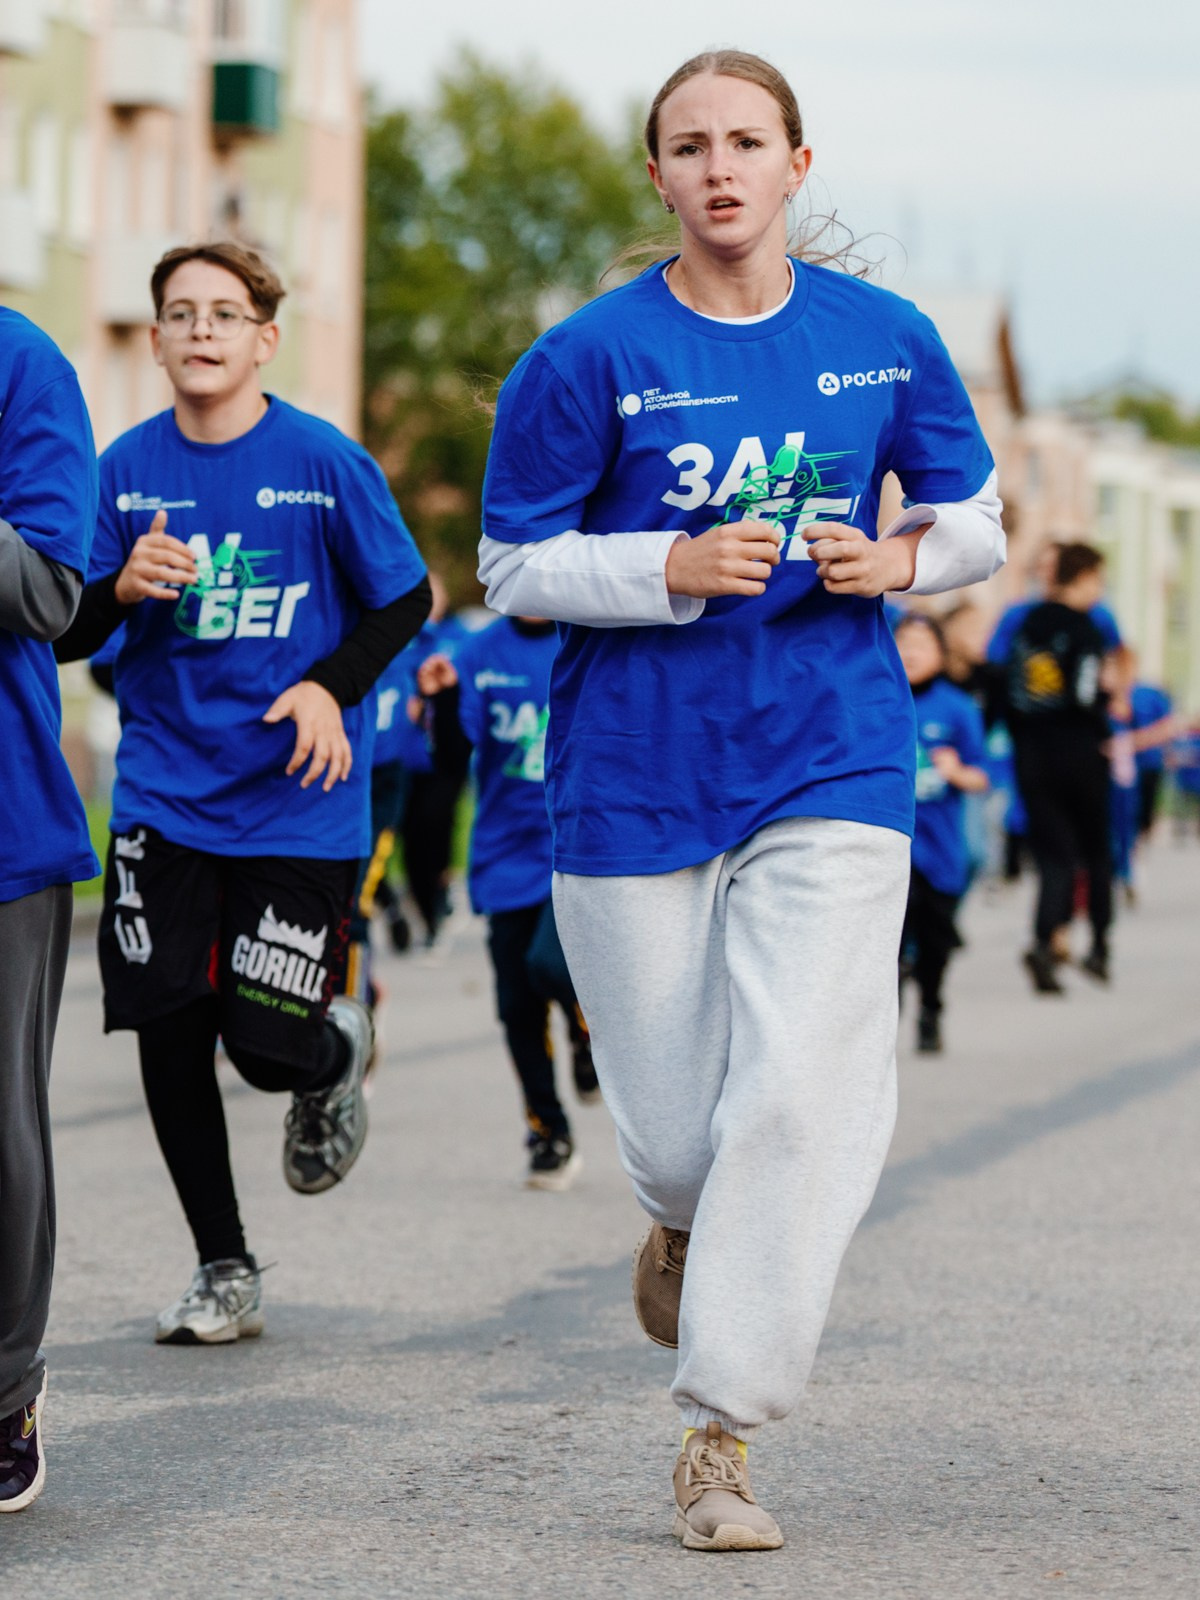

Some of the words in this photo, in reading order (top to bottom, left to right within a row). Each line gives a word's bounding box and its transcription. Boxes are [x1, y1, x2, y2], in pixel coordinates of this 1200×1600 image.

[643, 387, 661, 397] ЛЕТ
[643, 390, 690, 405] АТОМНОЙ
[645, 394, 739, 413] ПРОМЫШЛЕННОСТИ
[661, 431, 805, 511] ЗА!
[197, 581, 310, 640] БЕГ
